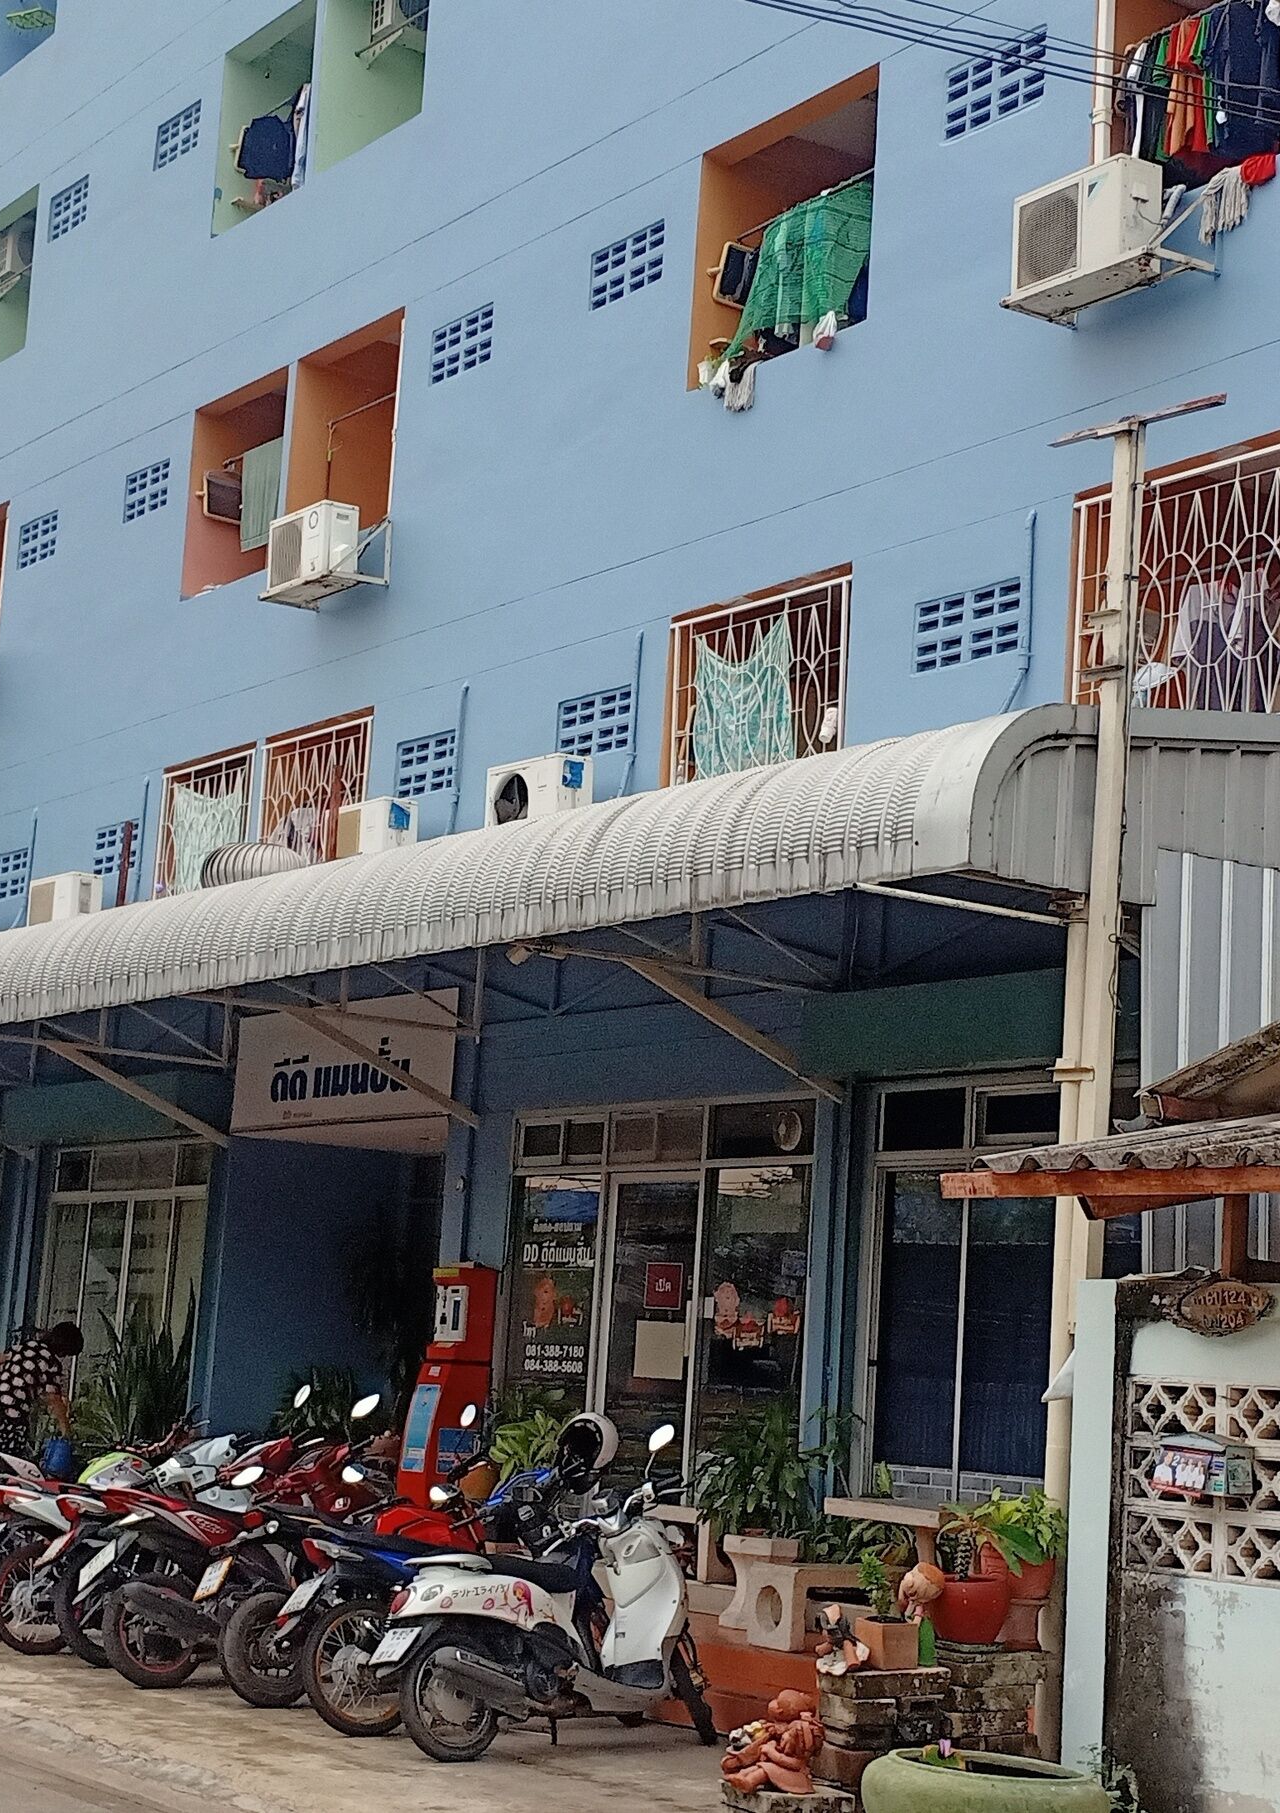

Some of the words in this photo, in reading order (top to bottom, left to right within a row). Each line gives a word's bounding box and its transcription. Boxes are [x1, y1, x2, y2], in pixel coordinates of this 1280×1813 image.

[523, 1244, 539, 1262] DD
[655, 1277, 672, 1292] เปิด
[526, 1344, 585, 1358] 081-388-7180
[524, 1359, 583, 1374] 084-388-5608
[1172, 1455, 1181, 1466] 2
